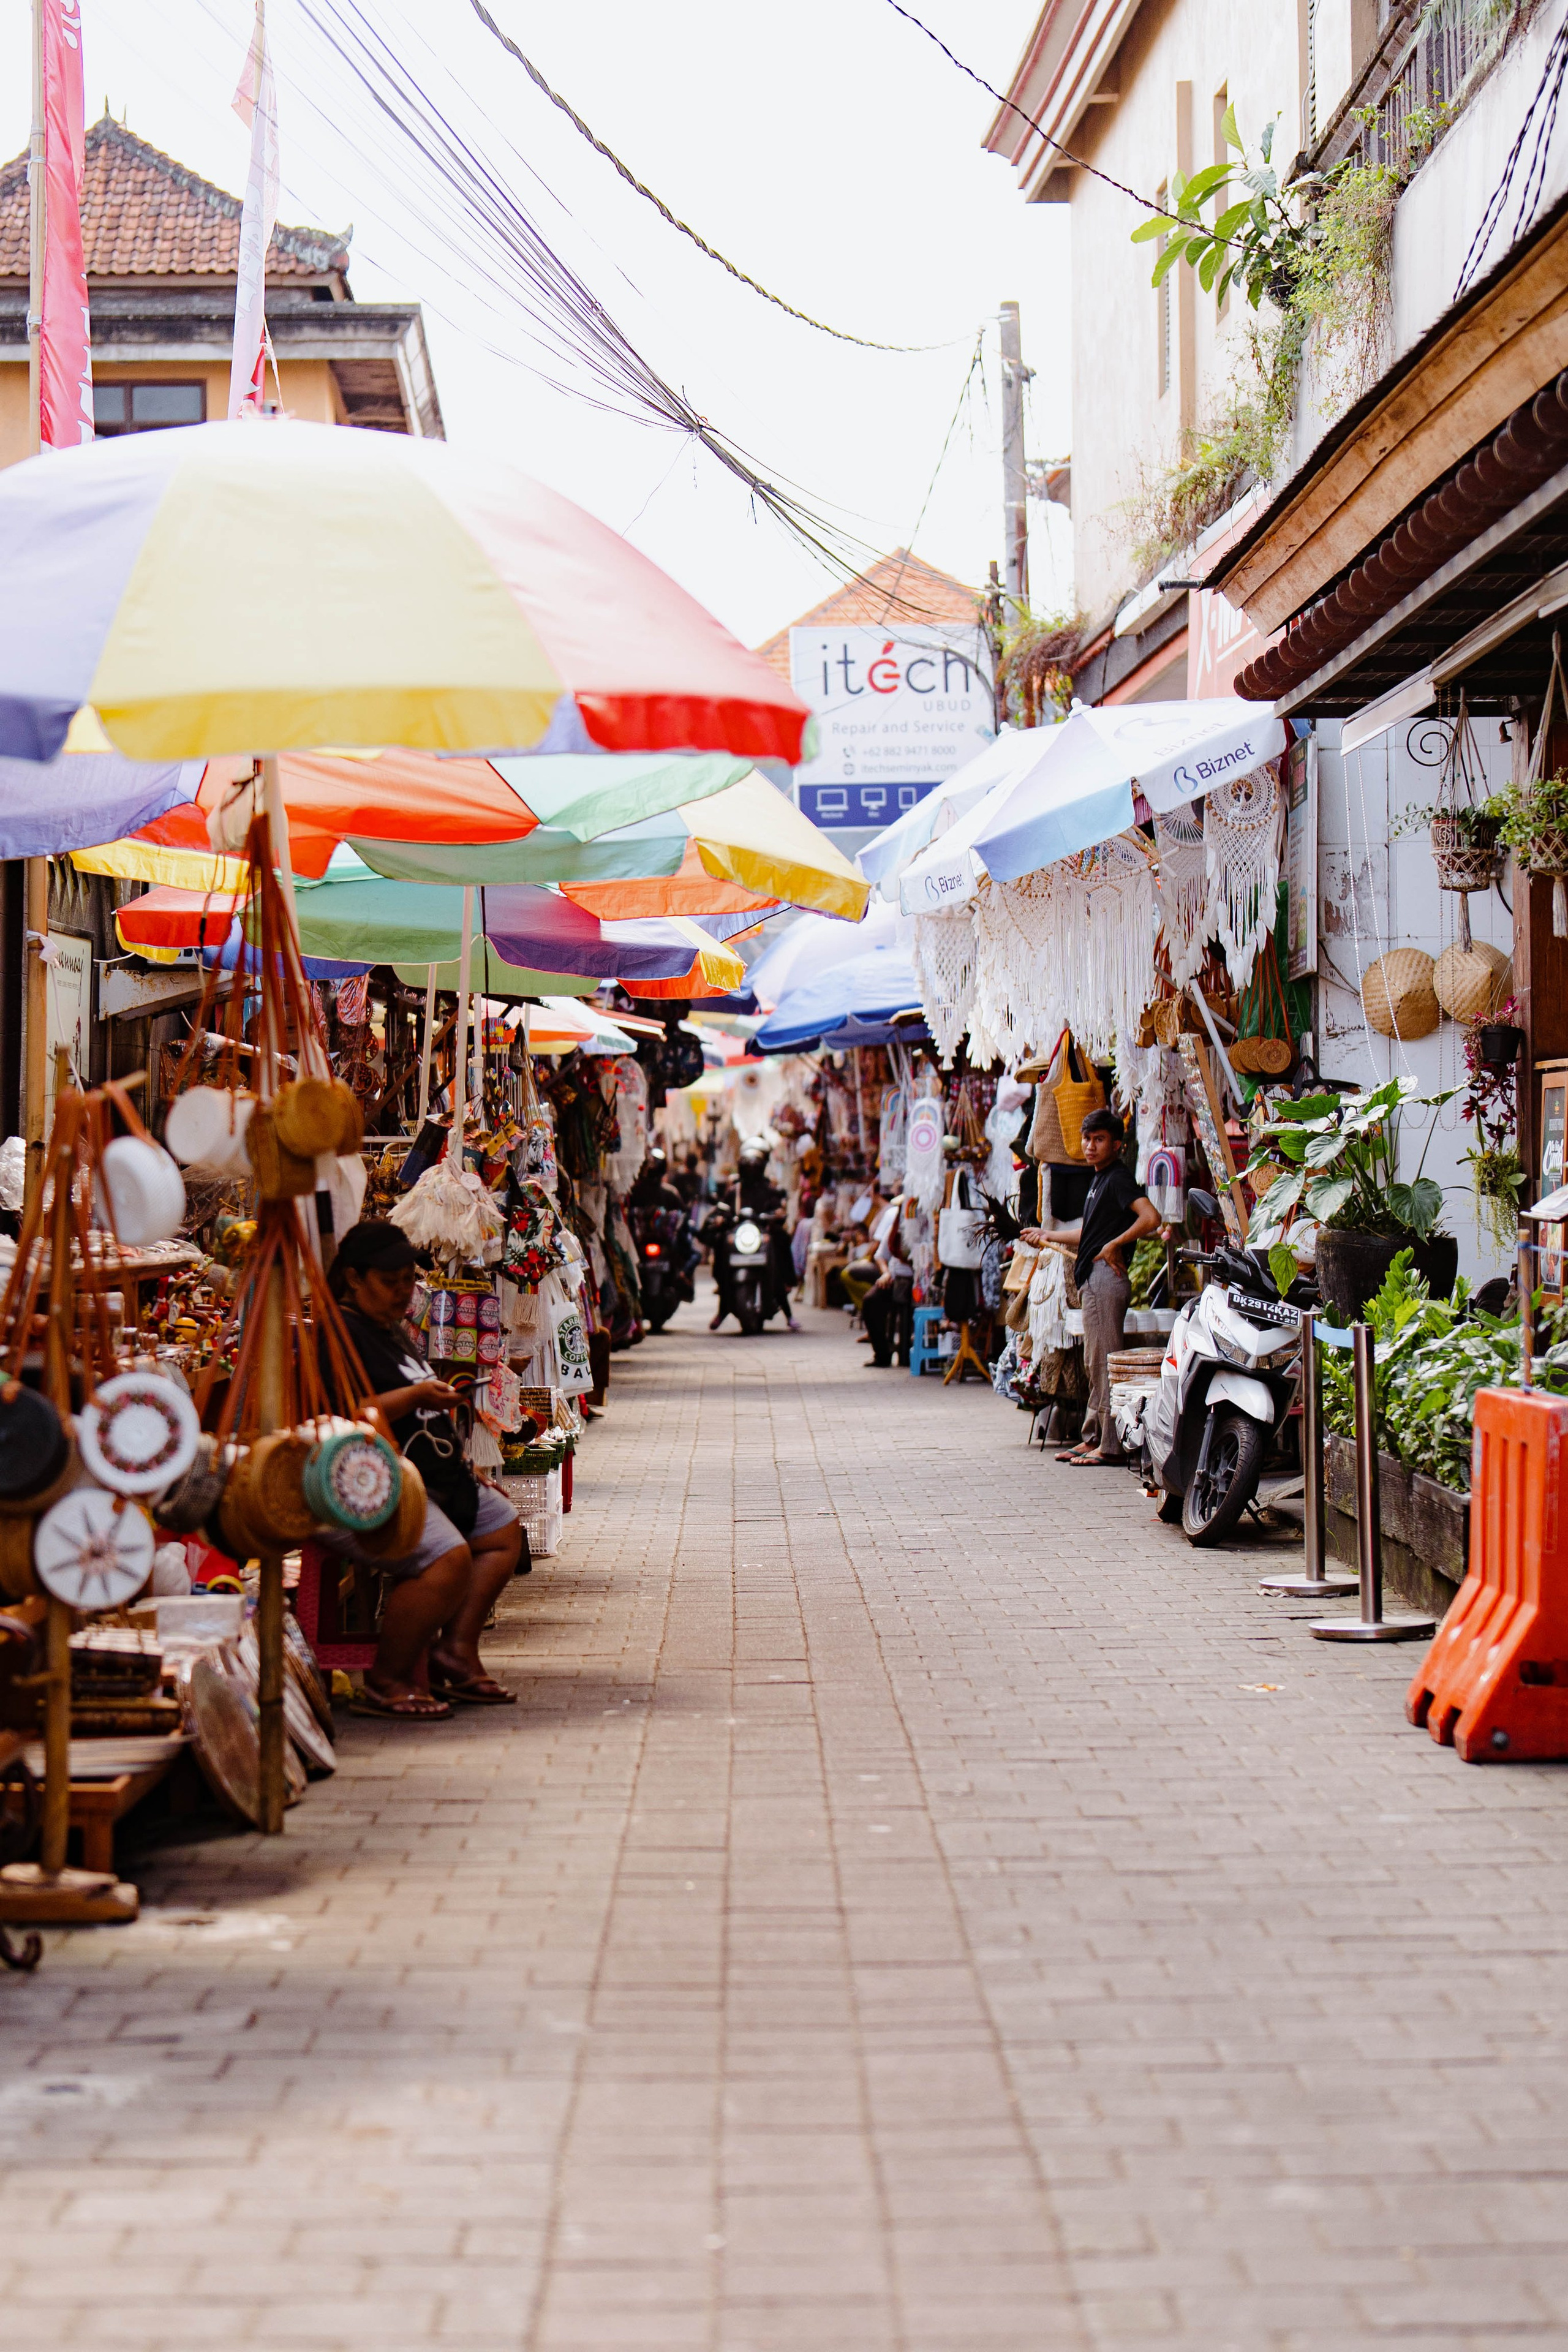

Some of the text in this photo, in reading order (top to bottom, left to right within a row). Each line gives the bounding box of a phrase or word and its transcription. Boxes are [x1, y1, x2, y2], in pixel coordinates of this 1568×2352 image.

[923, 699, 971, 712] UBUD
[832, 720, 966, 736] Repair and Service
[1196, 741, 1255, 780] Biznet
[558, 1316, 581, 1339] STARB
